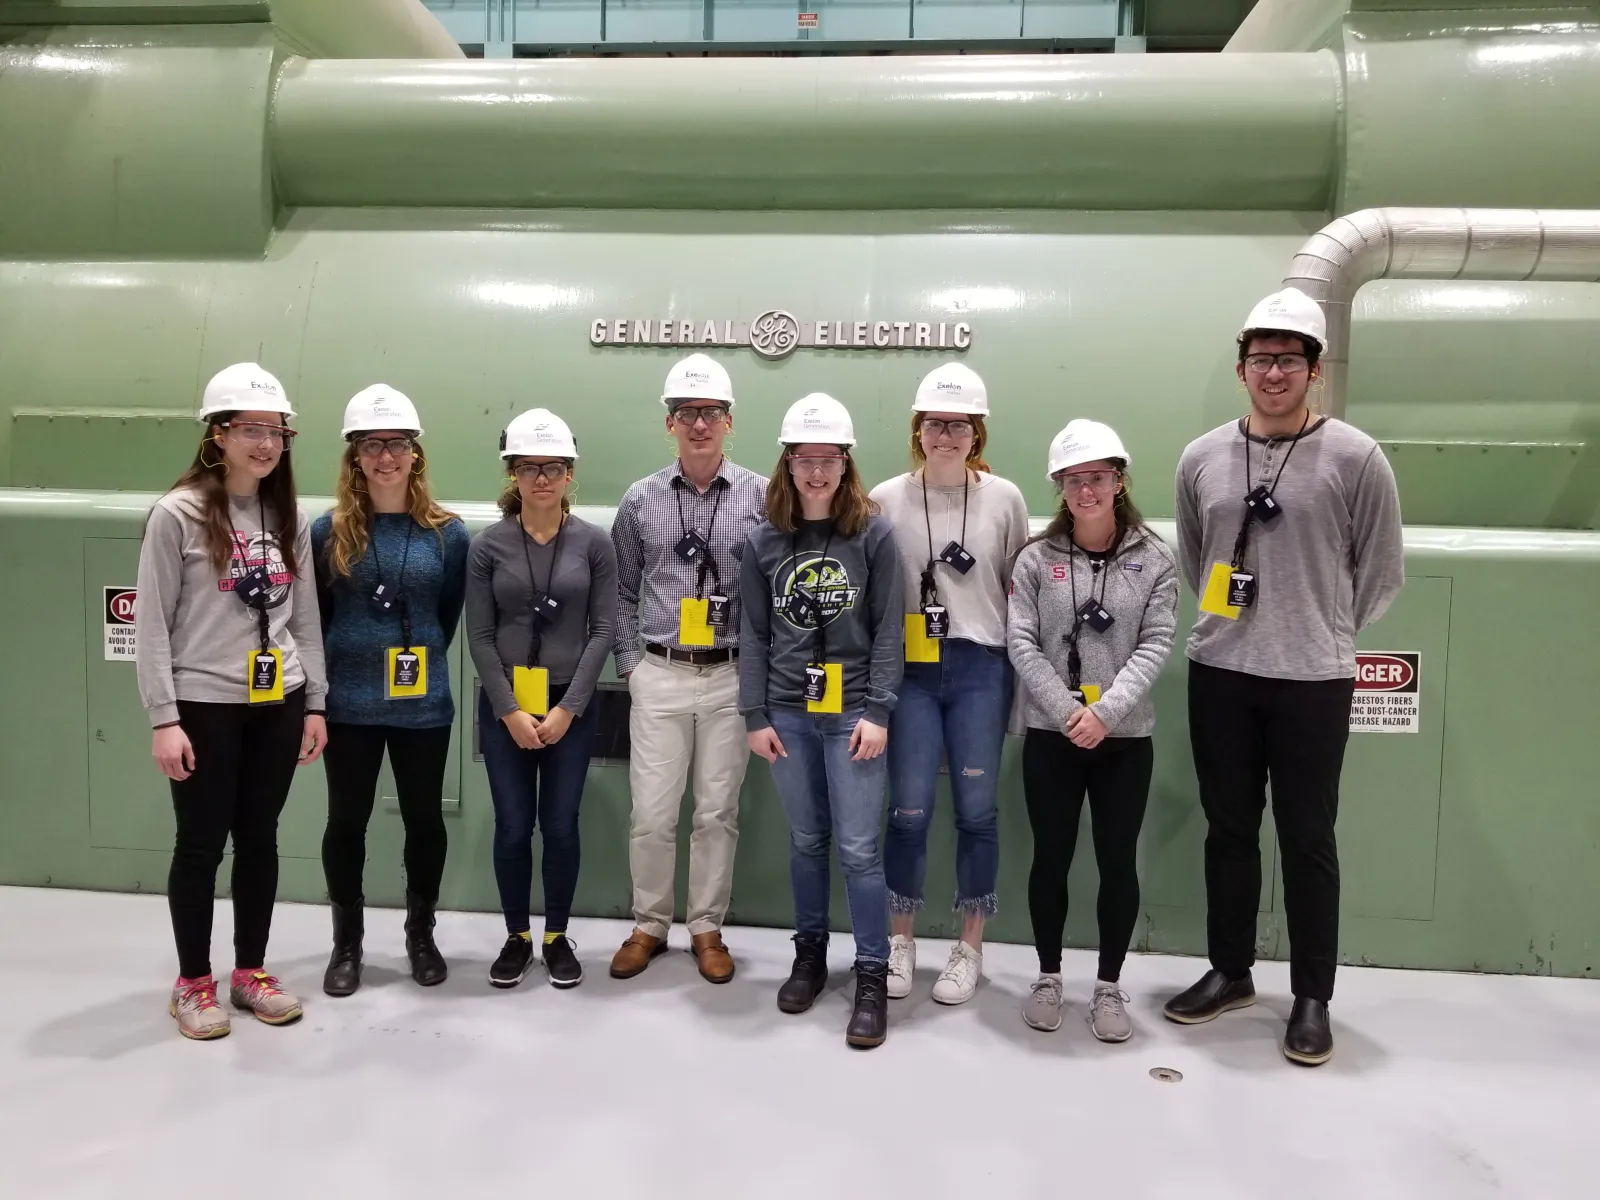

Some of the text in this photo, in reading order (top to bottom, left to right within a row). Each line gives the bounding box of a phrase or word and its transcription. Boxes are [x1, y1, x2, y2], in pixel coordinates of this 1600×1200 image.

[591, 318, 737, 344] GENERAL
[814, 320, 971, 348] ELECTRIC
[1052, 566, 1066, 579] S
[1237, 580, 1246, 590] V
[714, 601, 722, 611] V
[821, 608, 838, 616] 2017
[931, 612, 940, 622] V
[108, 636, 127, 645] AVOID
[113, 646, 126, 655] AND
[261, 662, 269, 672] V
[402, 661, 411, 670] V
[810, 674, 819, 684] V
[1352, 695, 1413, 706] SBESTOS FIBERS
[1367, 706, 1417, 716] DUST-CANCER
[1349, 716, 1411, 726] DISEASE HAZARD
